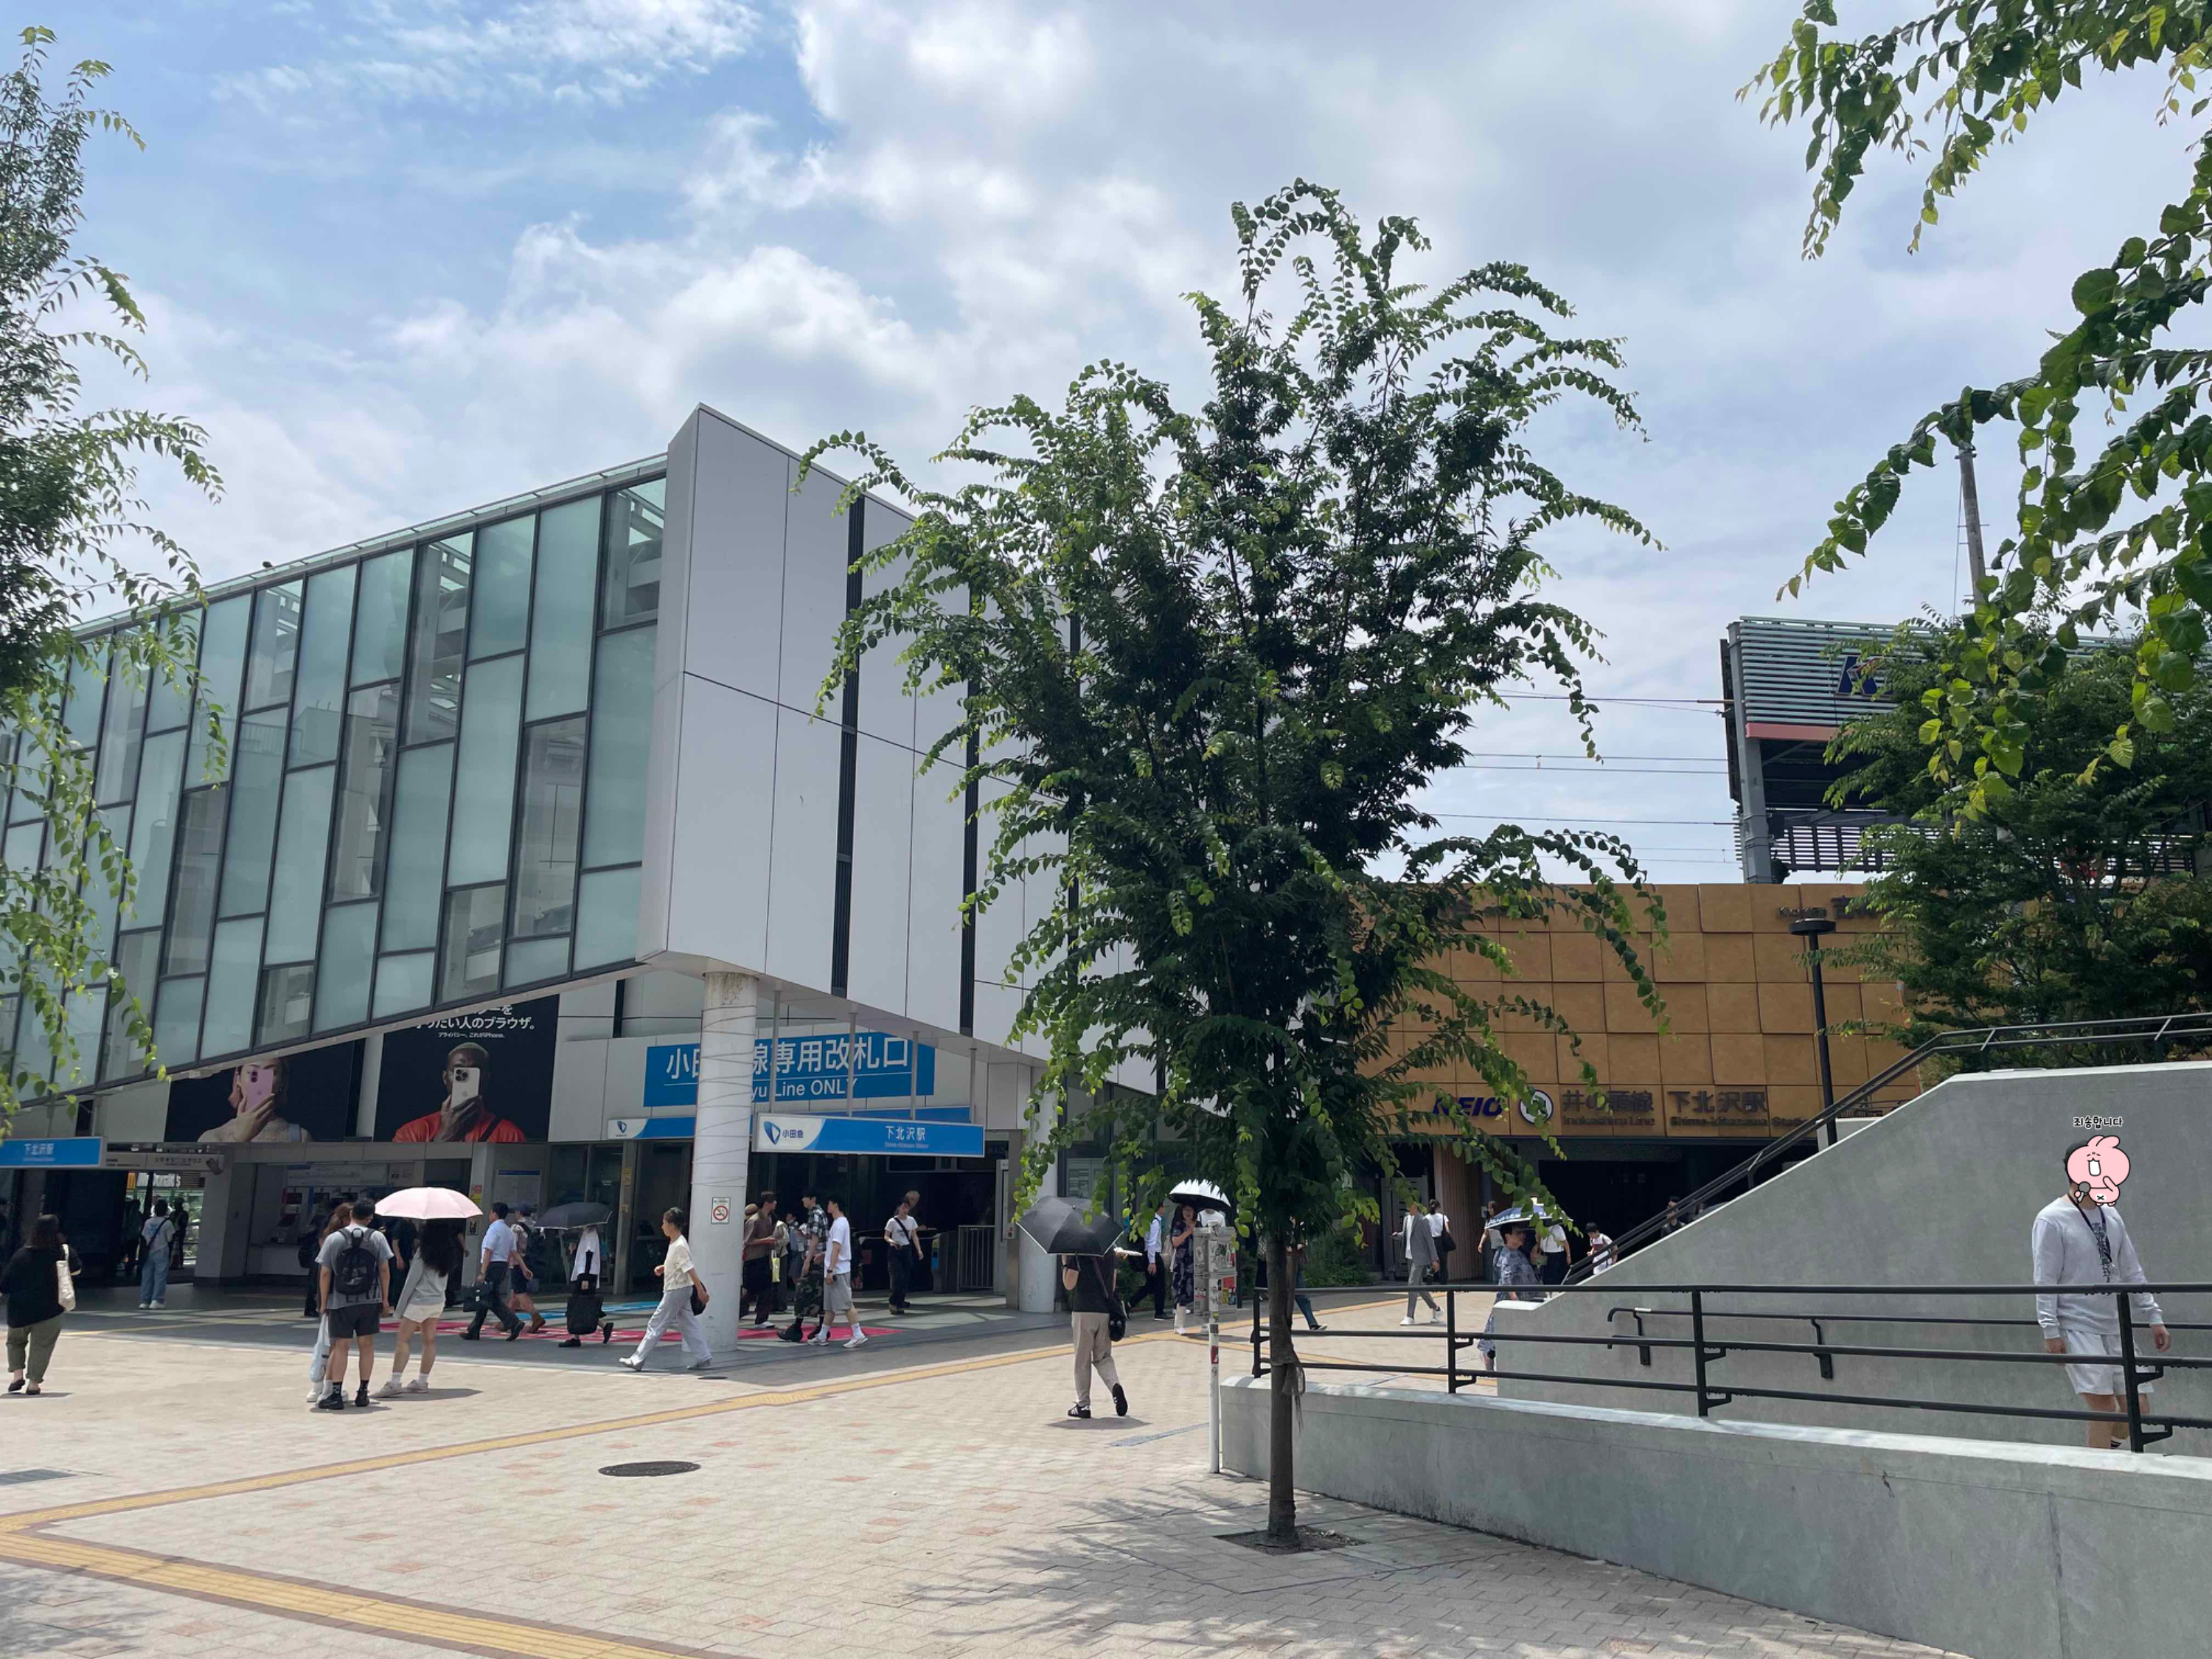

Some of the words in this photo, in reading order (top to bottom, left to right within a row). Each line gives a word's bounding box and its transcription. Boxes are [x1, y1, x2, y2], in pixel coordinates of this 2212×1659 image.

[1562, 1090, 1655, 1113] 井の頭線
[1668, 1091, 1768, 1113] 下北沢駅
[1630, 1116, 1655, 1126] Line
[782, 1130, 804, 1138] 小田急
[886, 1125, 926, 1141] 下北沢駅
